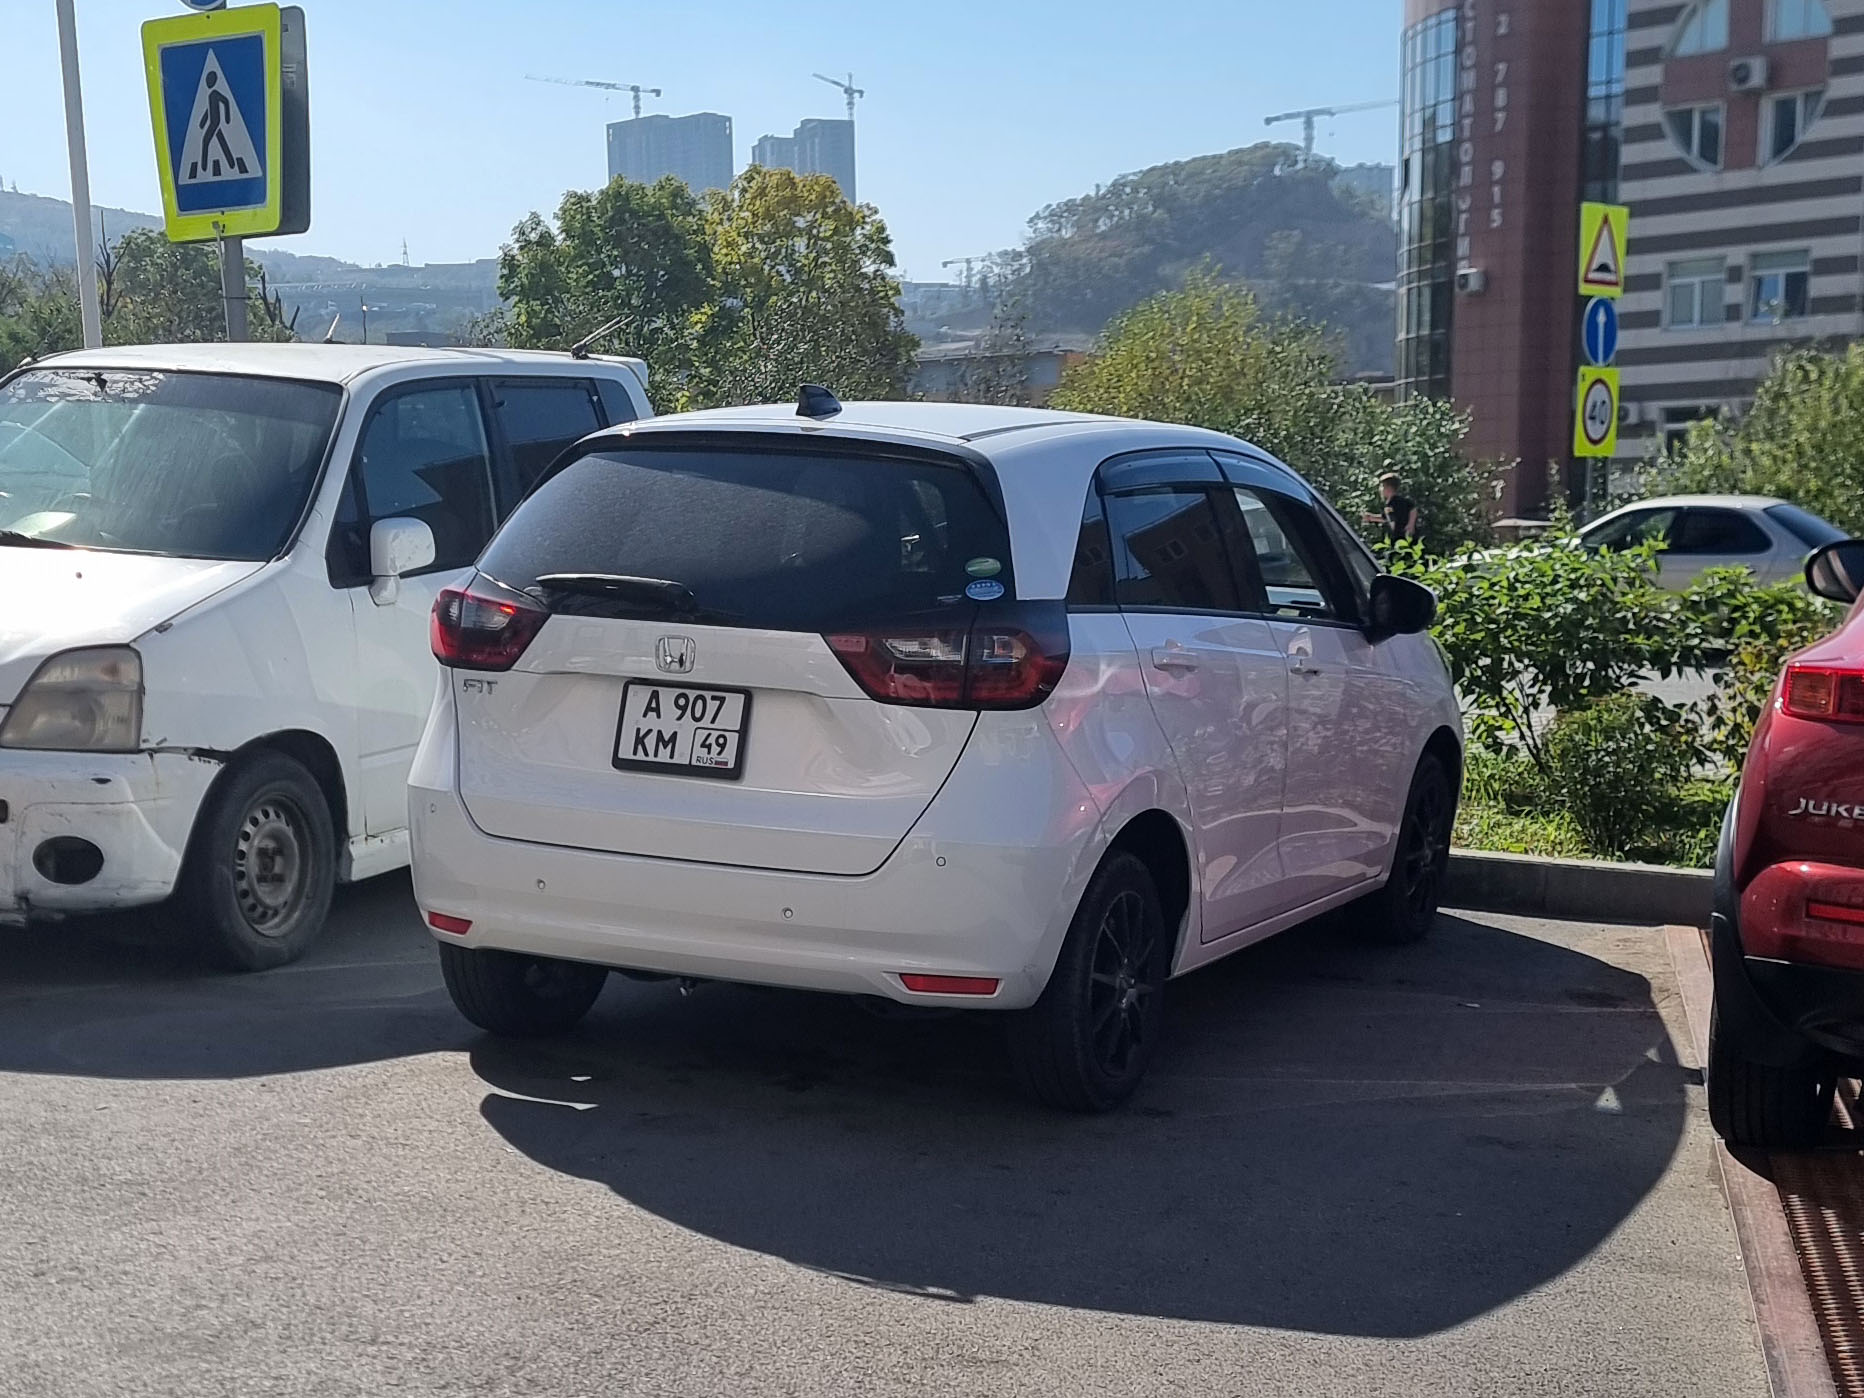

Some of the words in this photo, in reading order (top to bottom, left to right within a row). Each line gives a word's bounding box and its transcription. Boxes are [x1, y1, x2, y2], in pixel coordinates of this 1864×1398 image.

[1490, 160, 1505, 228] 915
[1588, 400, 1608, 426] 40
[673, 692, 726, 724] 907
[700, 732, 728, 756] 49
[695, 756, 714, 765] RUS
[1788, 797, 1864, 820] JUKE
